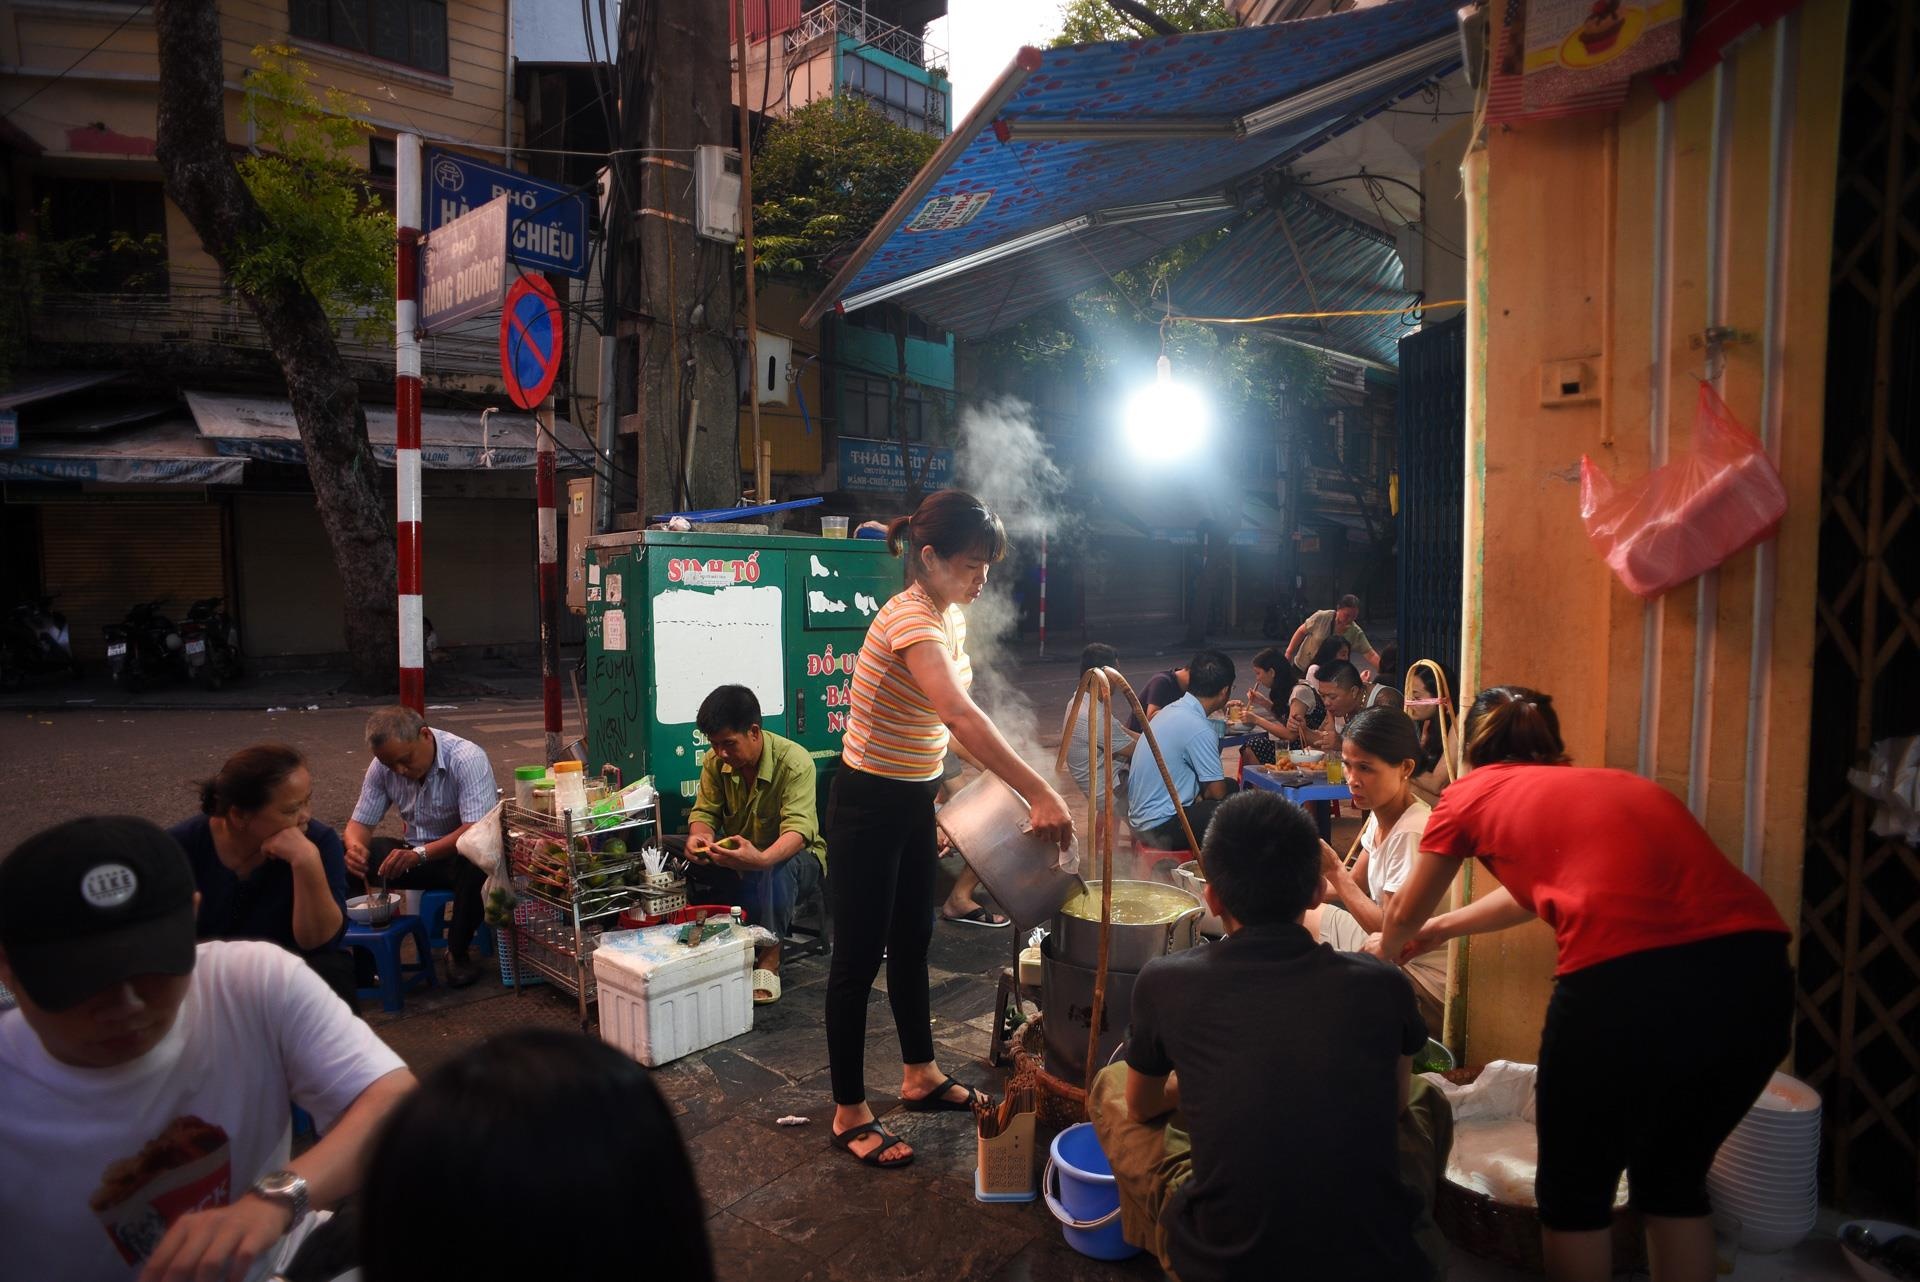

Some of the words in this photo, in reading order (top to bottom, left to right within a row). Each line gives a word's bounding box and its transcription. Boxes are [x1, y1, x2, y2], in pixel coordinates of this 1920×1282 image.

[492, 184, 537, 210] PHỐ
[452, 230, 477, 258] PHỐ
[512, 220, 574, 261] CHIẾU
[422, 275, 454, 318] HÀNG
[456, 255, 499, 304] ĐƯỜNG
[731, 550, 761, 583] TỐ
[807, 644, 836, 676] ĐỒ
